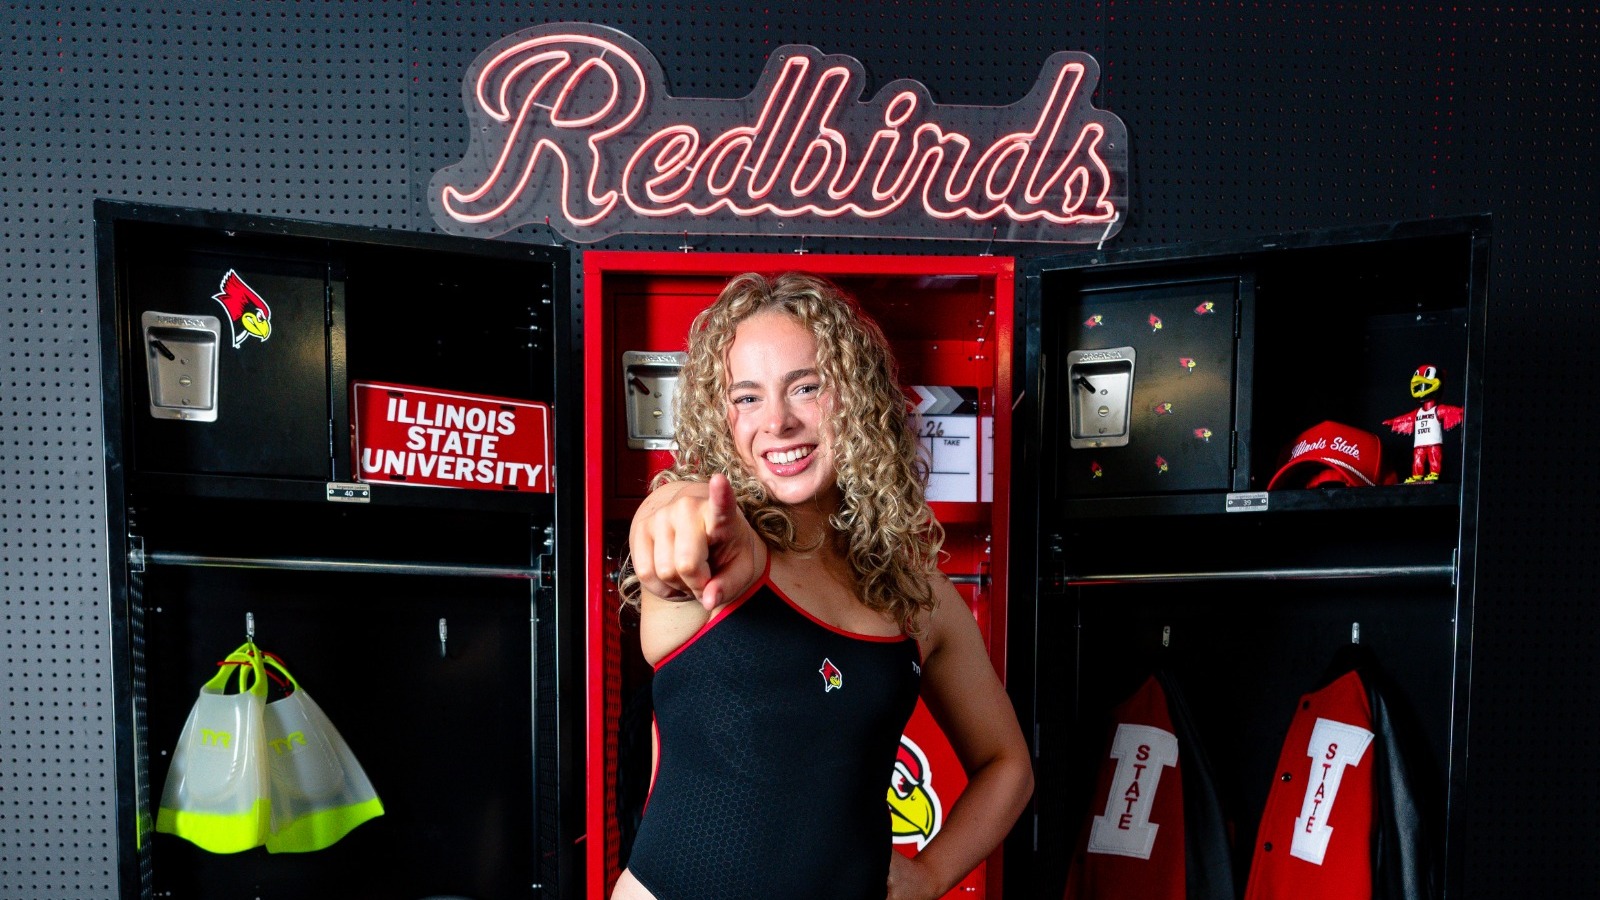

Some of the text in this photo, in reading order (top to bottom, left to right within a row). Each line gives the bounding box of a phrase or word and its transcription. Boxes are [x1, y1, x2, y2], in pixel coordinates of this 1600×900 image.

[441, 33, 1115, 226] Redbirds
[386, 397, 516, 436] ILLINOIS
[406, 426, 499, 459] STATE
[1330, 436, 1360, 460] State
[362, 448, 543, 487] UNIVERSITY
[911, 660, 921, 677] TY
[201, 728, 231, 749] TYR
[269, 731, 306, 756] TYR
[1118, 744, 1151, 830] STATE
[1305, 743, 1338, 833] STATE
